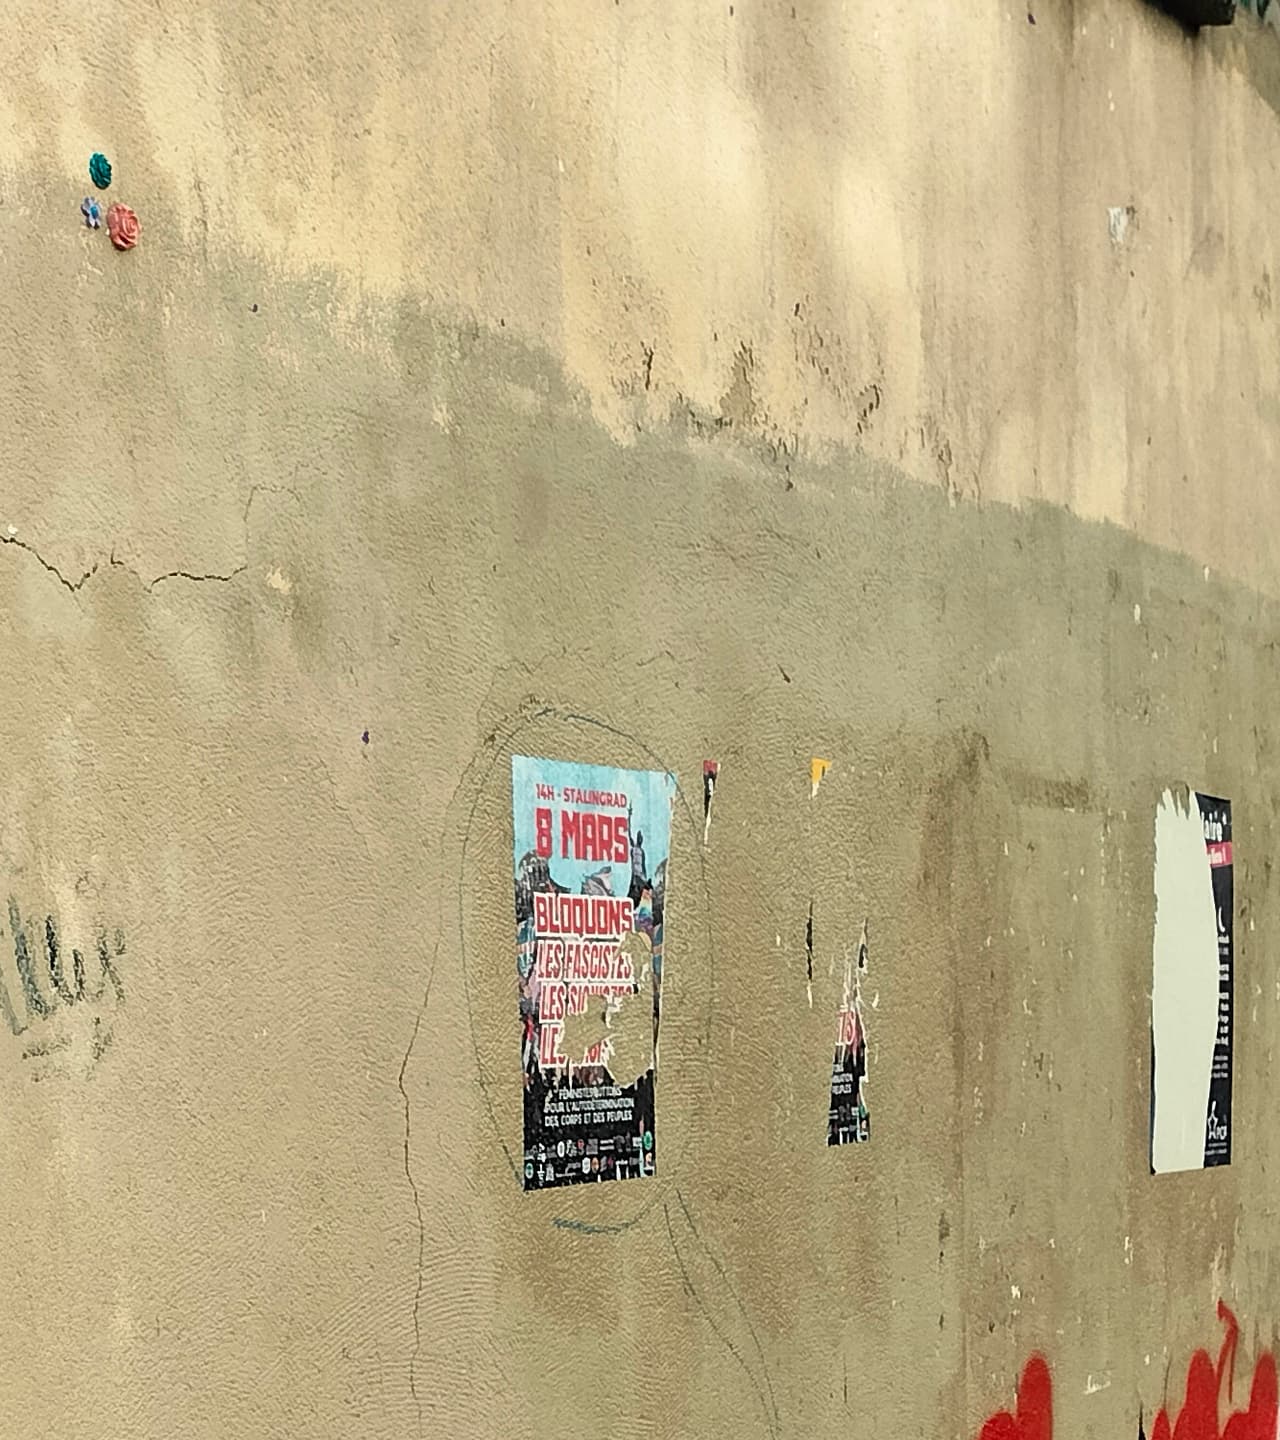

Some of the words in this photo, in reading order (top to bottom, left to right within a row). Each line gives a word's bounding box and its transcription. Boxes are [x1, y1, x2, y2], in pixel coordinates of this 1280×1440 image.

[536, 783, 554, 801] 14H
[563, 787, 628, 809] STALINGRAD
[535, 807, 552, 860] 8
[561, 809, 629, 864] MARS
[535, 896, 632, 936] BLOQUONS
[537, 943, 562, 979] LES
[564, 943, 632, 980] FASCISTES
[541, 985, 565, 1021] LES
[543, 1101, 564, 1114] POUR
[544, 1115, 559, 1128] DES
[560, 1113, 582, 1126] CORPS
[593, 1112, 605, 1123] DES
